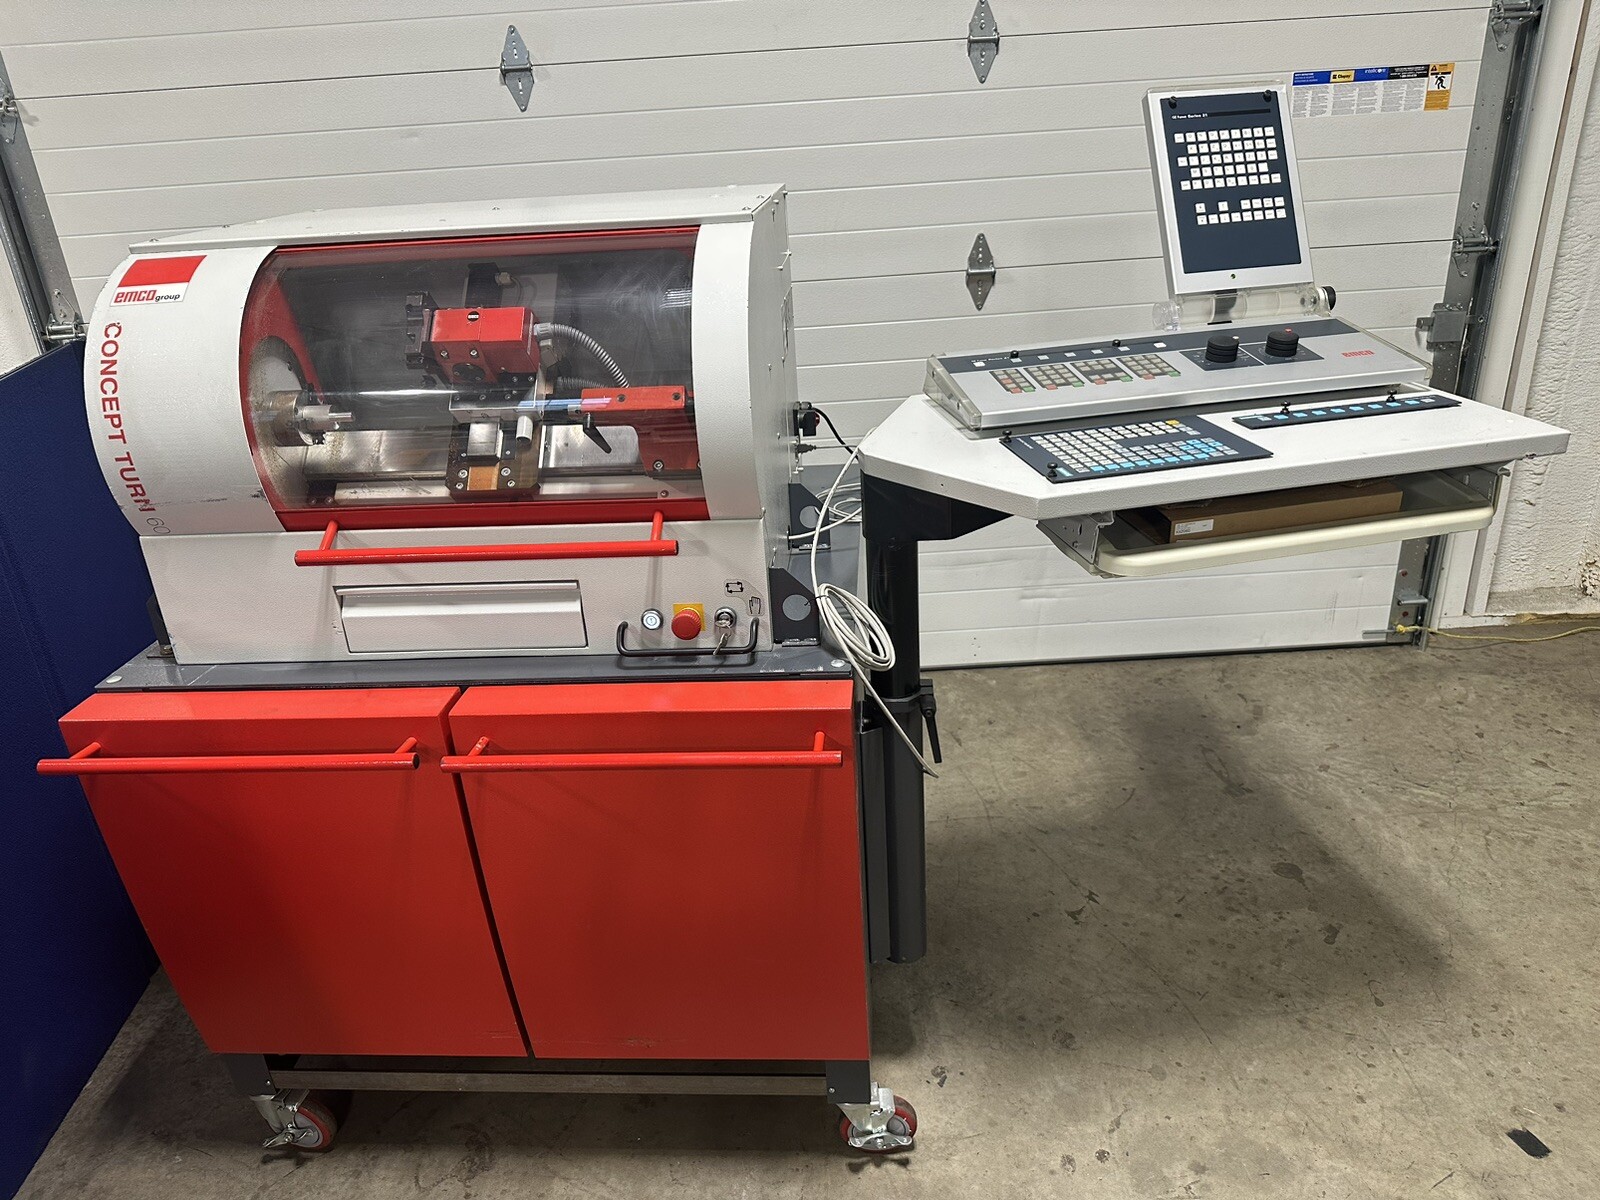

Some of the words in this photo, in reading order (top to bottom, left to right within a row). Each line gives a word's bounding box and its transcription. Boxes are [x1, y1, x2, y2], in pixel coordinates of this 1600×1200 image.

[100, 322, 127, 444] CONCEPT
[114, 451, 157, 512] TURN
[146, 517, 171, 535] 60
